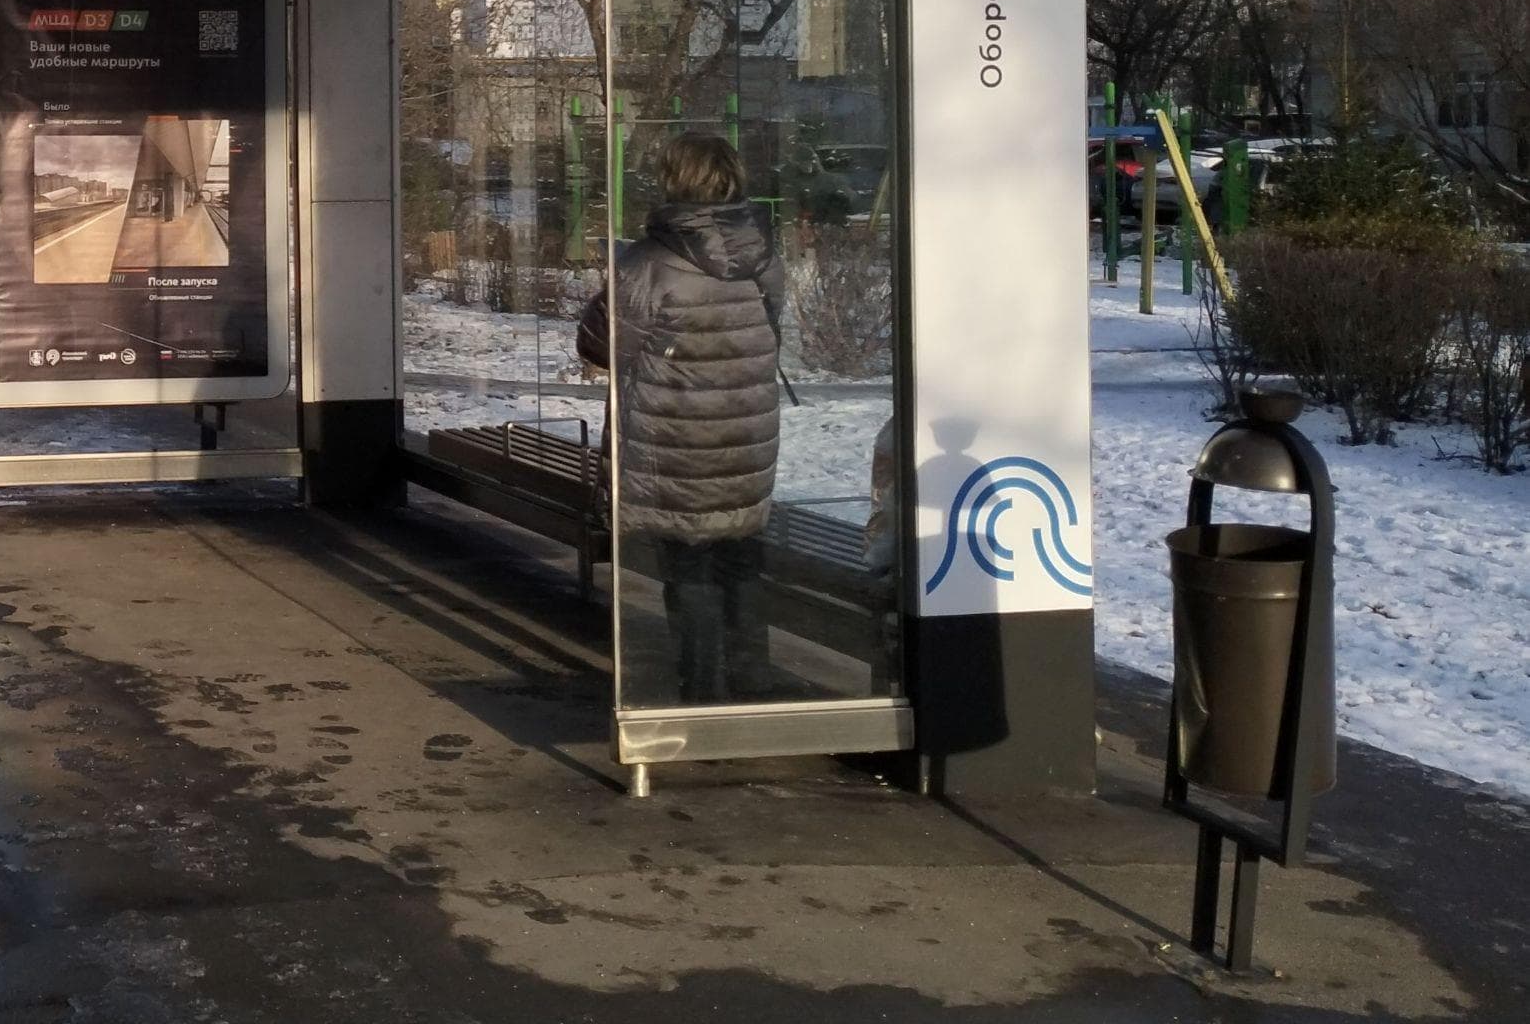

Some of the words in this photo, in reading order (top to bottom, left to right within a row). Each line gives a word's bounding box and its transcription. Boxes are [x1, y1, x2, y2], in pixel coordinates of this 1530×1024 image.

[34, 14, 71, 27] МЦД
[84, 13, 107, 28] D3
[119, 13, 143, 28] D4
[29, 40, 65, 53] Ваши
[69, 42, 111, 53] новые
[29, 54, 88, 69] удобные
[91, 57, 161, 70] маршруты
[43, 102, 71, 112] Было
[148, 277, 179, 286] После
[180, 278, 218, 288] запуска
